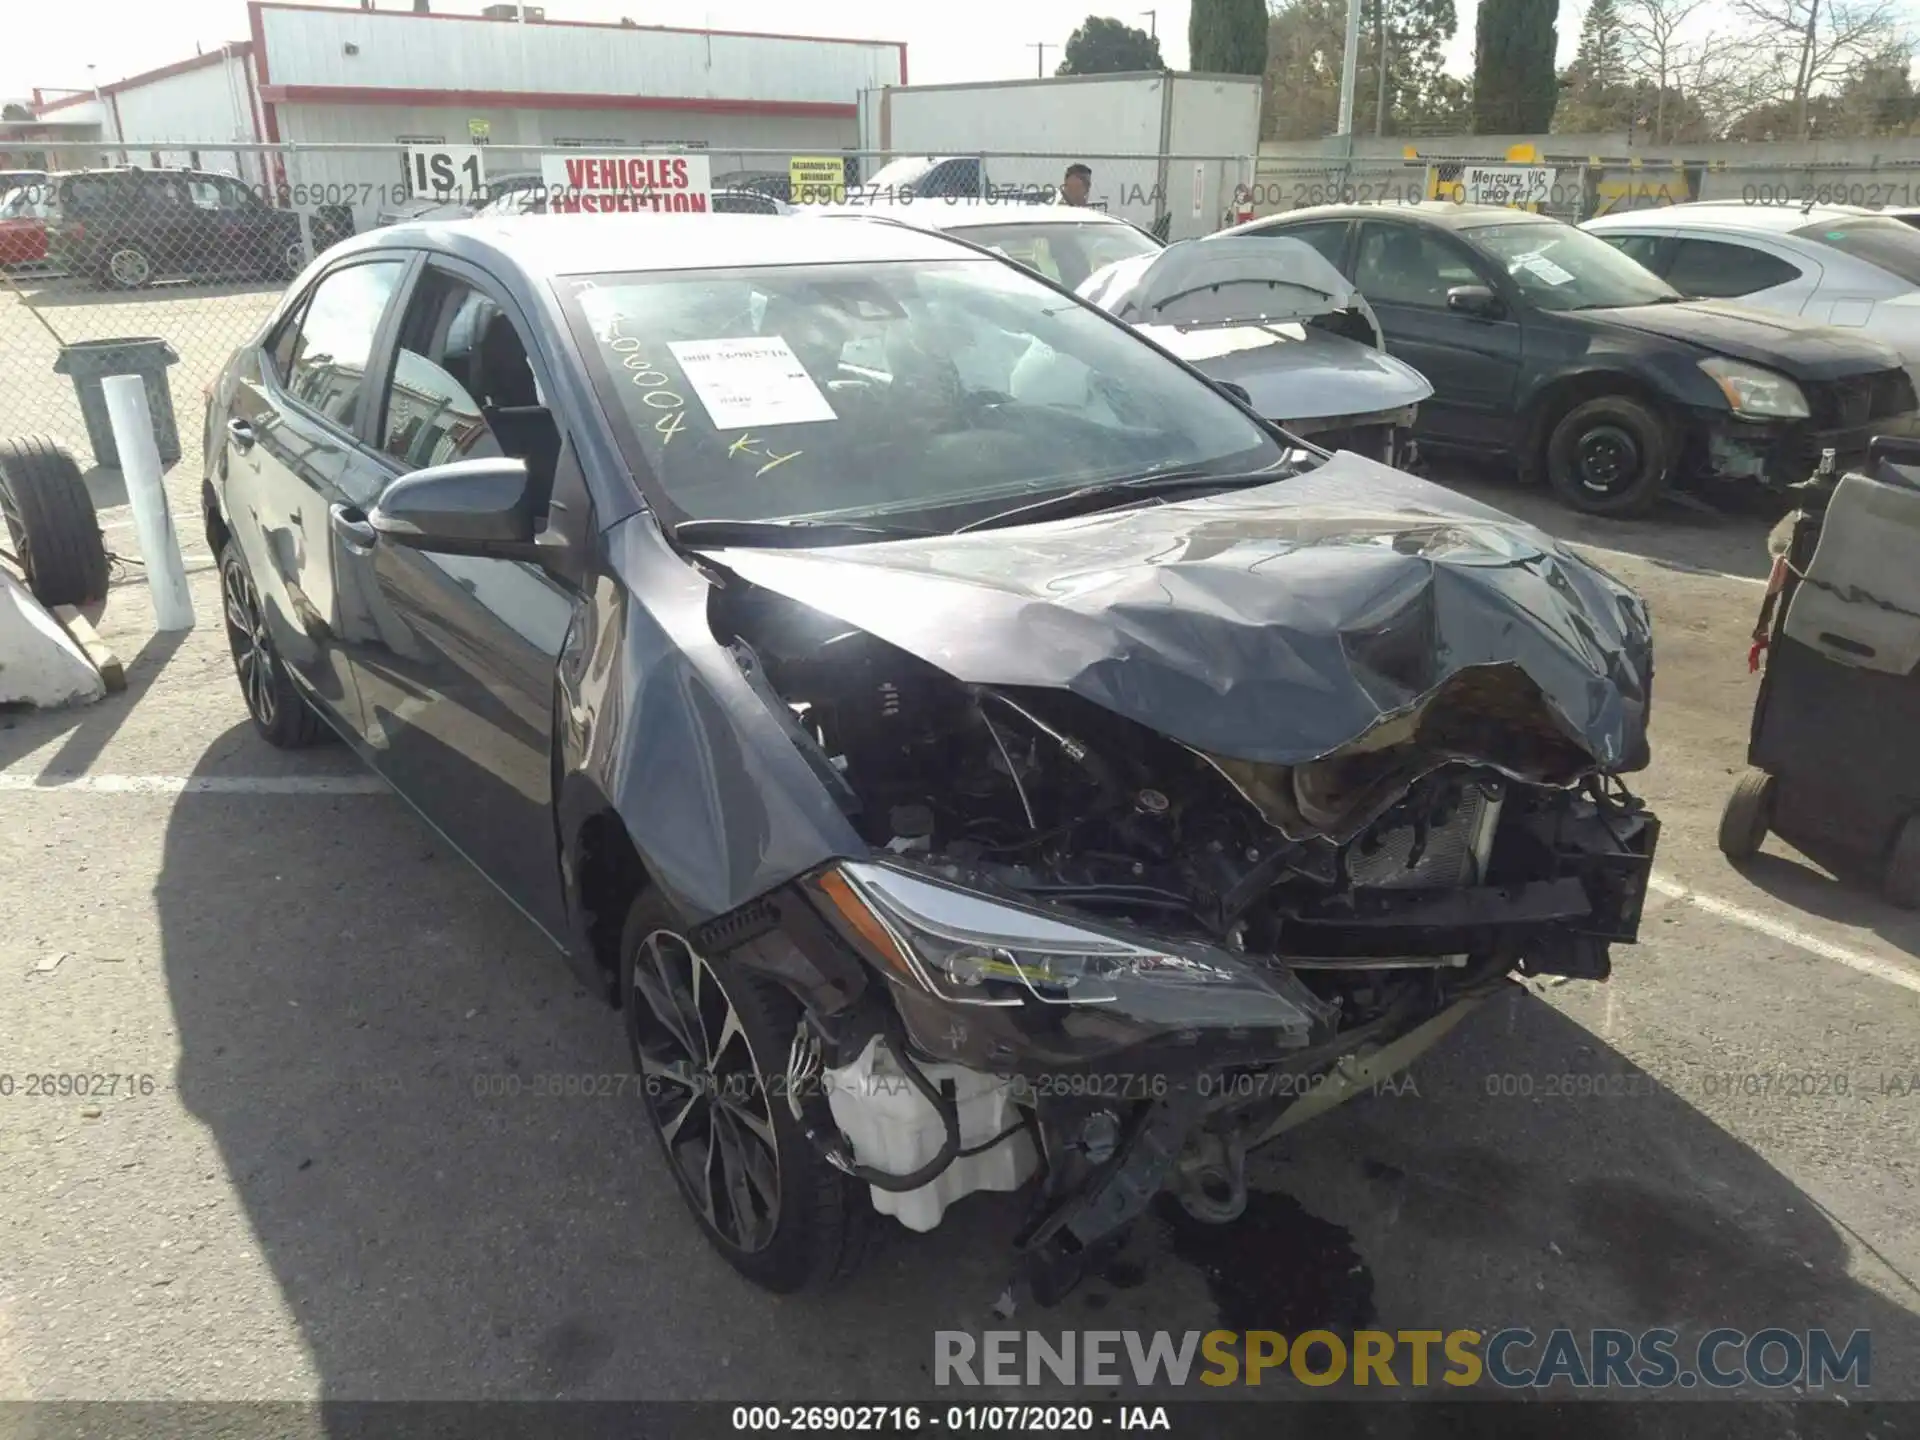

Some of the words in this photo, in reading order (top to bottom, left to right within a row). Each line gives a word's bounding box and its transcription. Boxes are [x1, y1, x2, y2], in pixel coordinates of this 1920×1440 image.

[415, 153, 455, 191] IS
[462, 154, 481, 191] 1
[565, 158, 690, 189] VEHICLES
[1472, 169, 1523, 185] Mercury
[1528, 170, 1547, 184] VIC
